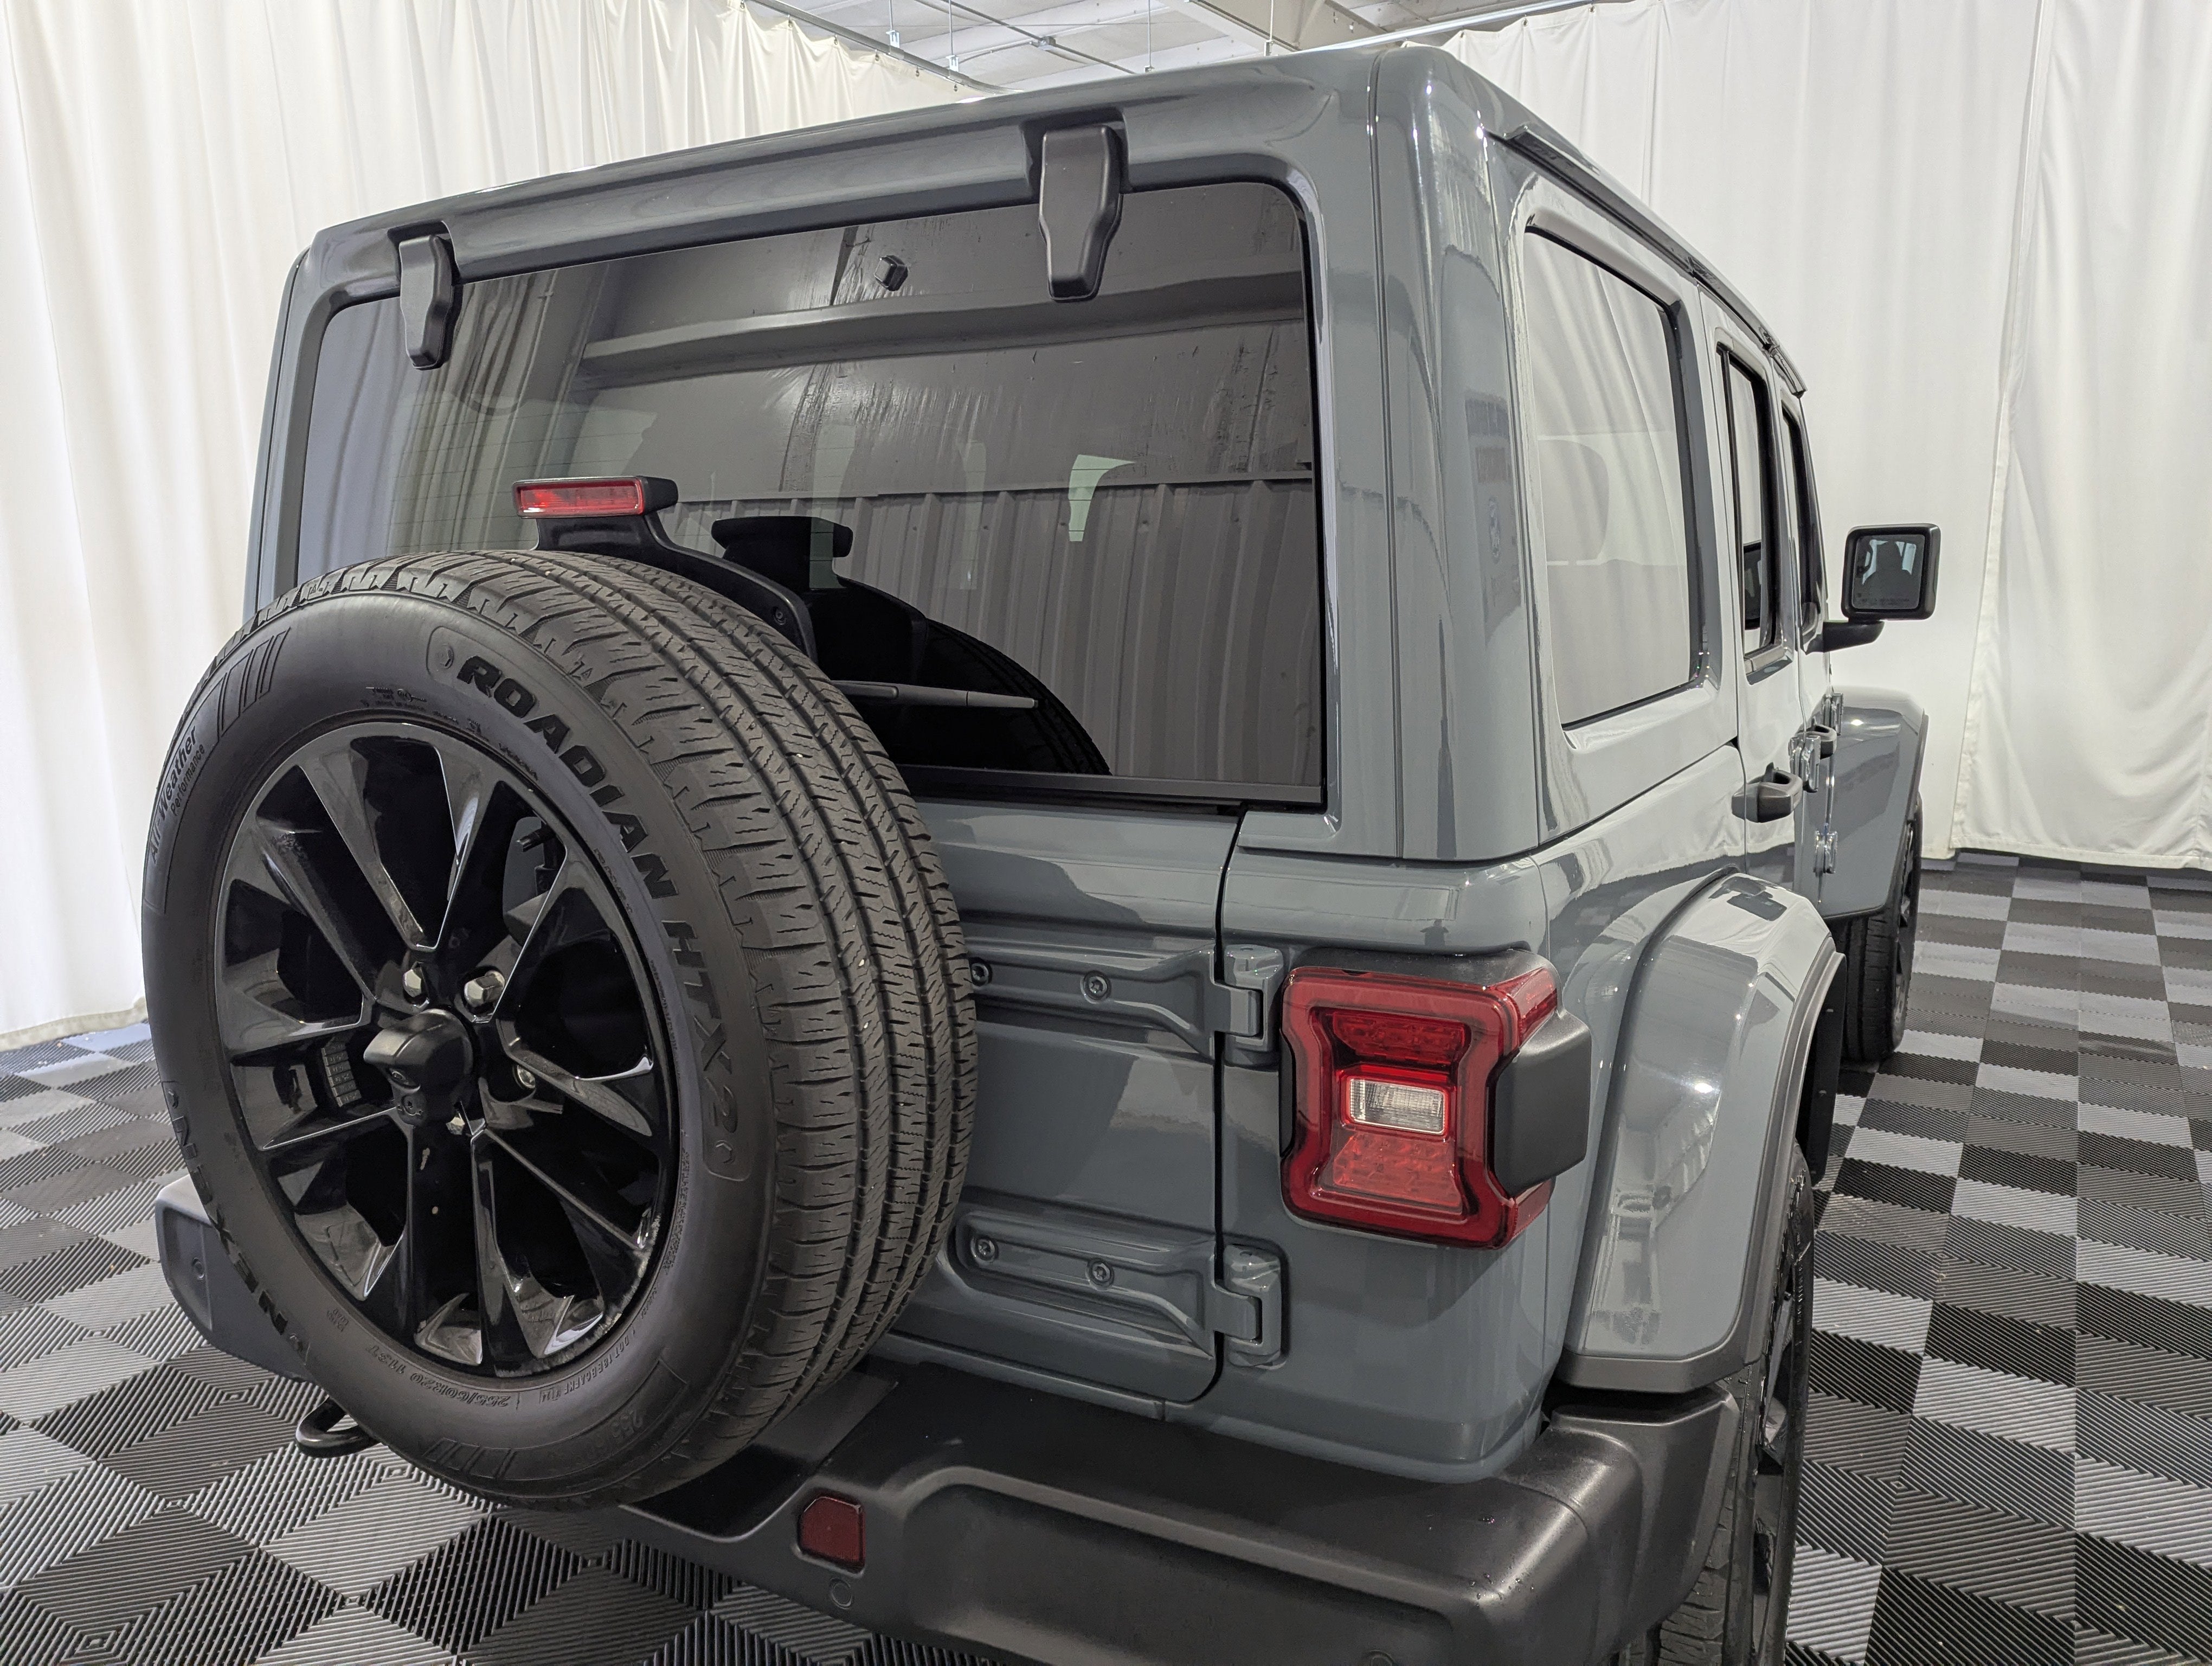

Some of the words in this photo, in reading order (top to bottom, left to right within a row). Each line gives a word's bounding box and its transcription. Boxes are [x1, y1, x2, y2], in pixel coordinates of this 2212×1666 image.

[149, 726, 197, 864] All-Weather
[171, 744, 205, 816] Performance
[457, 655, 679, 899] ROADIAN
[614, 1335, 630, 1358] DOT
[409, 1372, 511, 1408] 255/60R20
